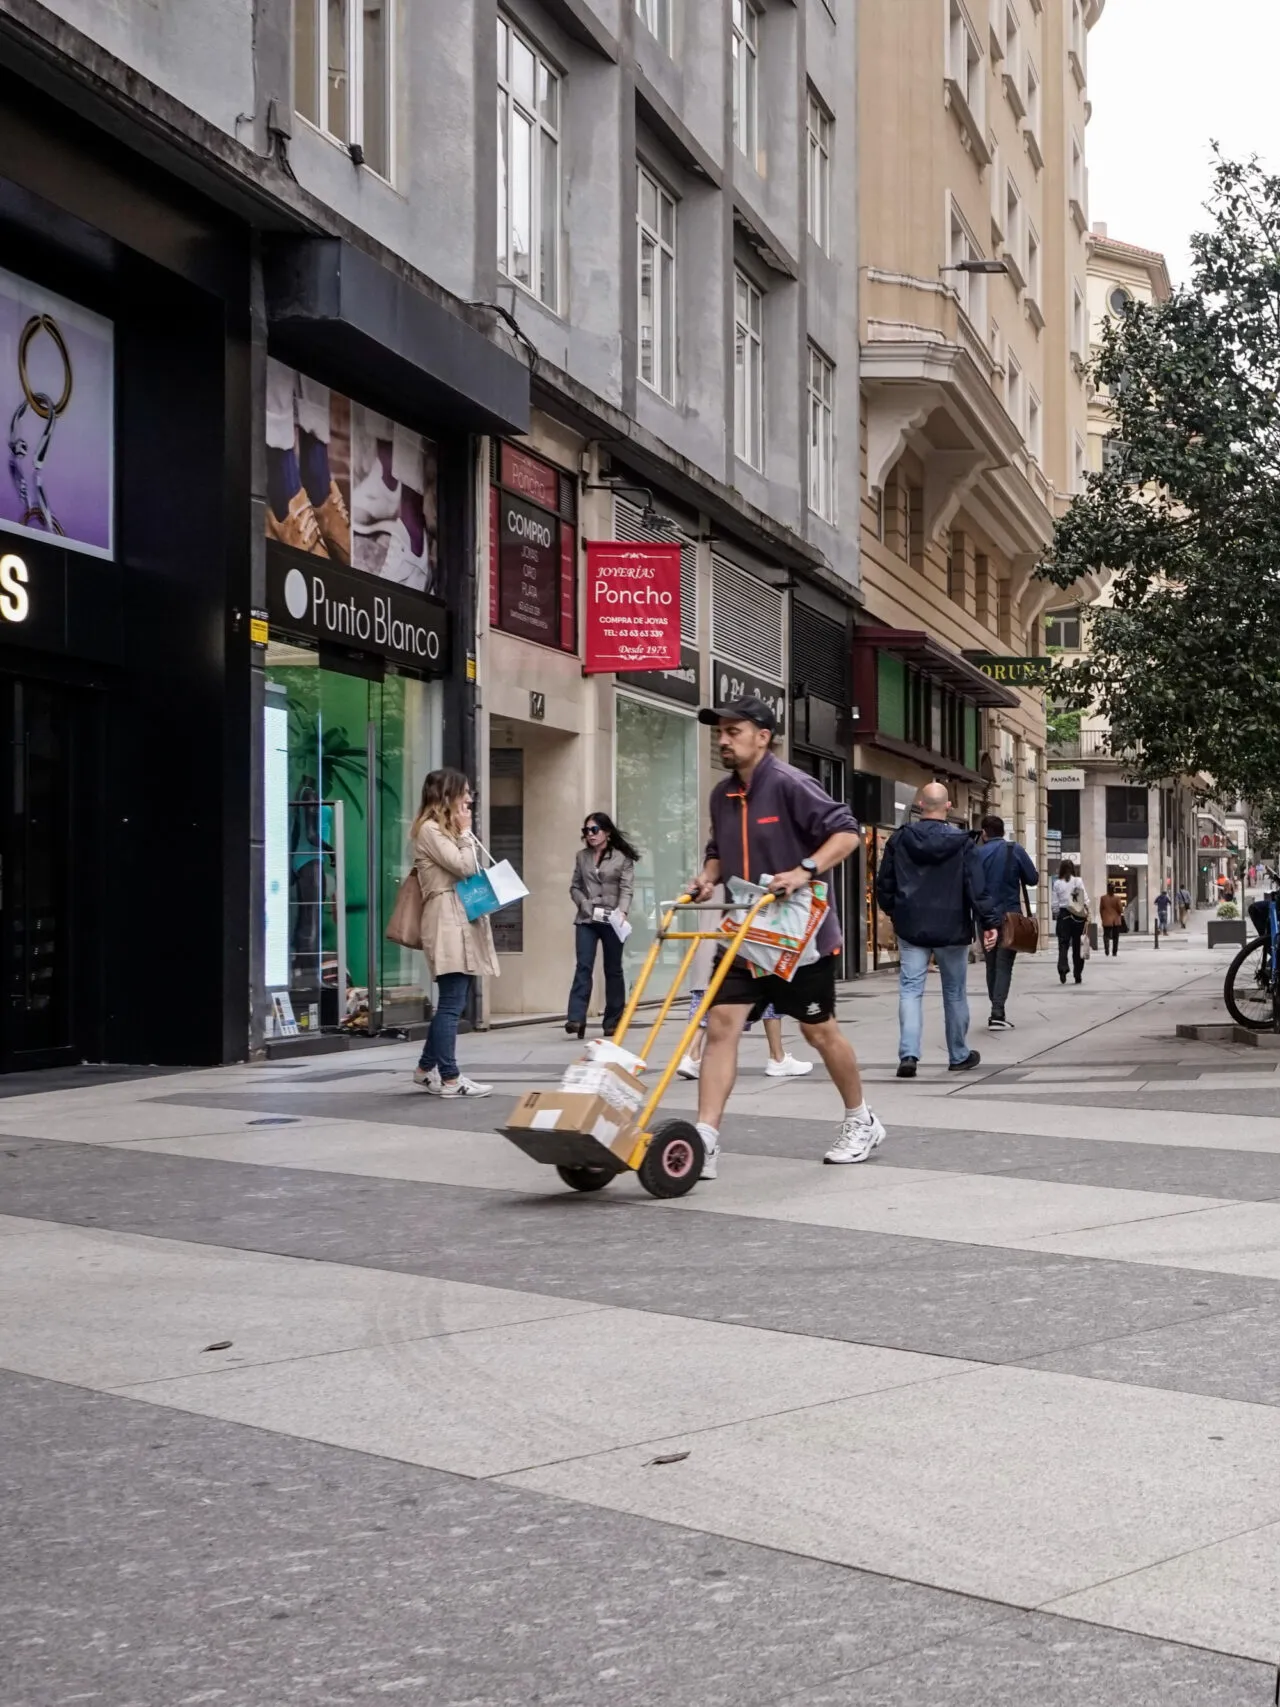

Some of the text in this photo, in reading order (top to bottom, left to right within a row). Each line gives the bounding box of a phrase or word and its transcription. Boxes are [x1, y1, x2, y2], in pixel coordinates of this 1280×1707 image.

[512, 462, 545, 500] Poncho
[507, 510, 551, 549] COMPRO
[596, 565, 656, 580] JOYERÍAS
[595, 580, 673, 605] Poncho
[312, 576, 440, 660] Punto Blanco
[599, 616, 632, 624] COMPRA
[645, 617, 669, 625] JOYAS
[603, 629, 618, 637] TEL:
[619, 629, 629, 637] 63
[618, 645, 668, 655] Desde 1975
[1106, 853, 1131, 862] KIKO
